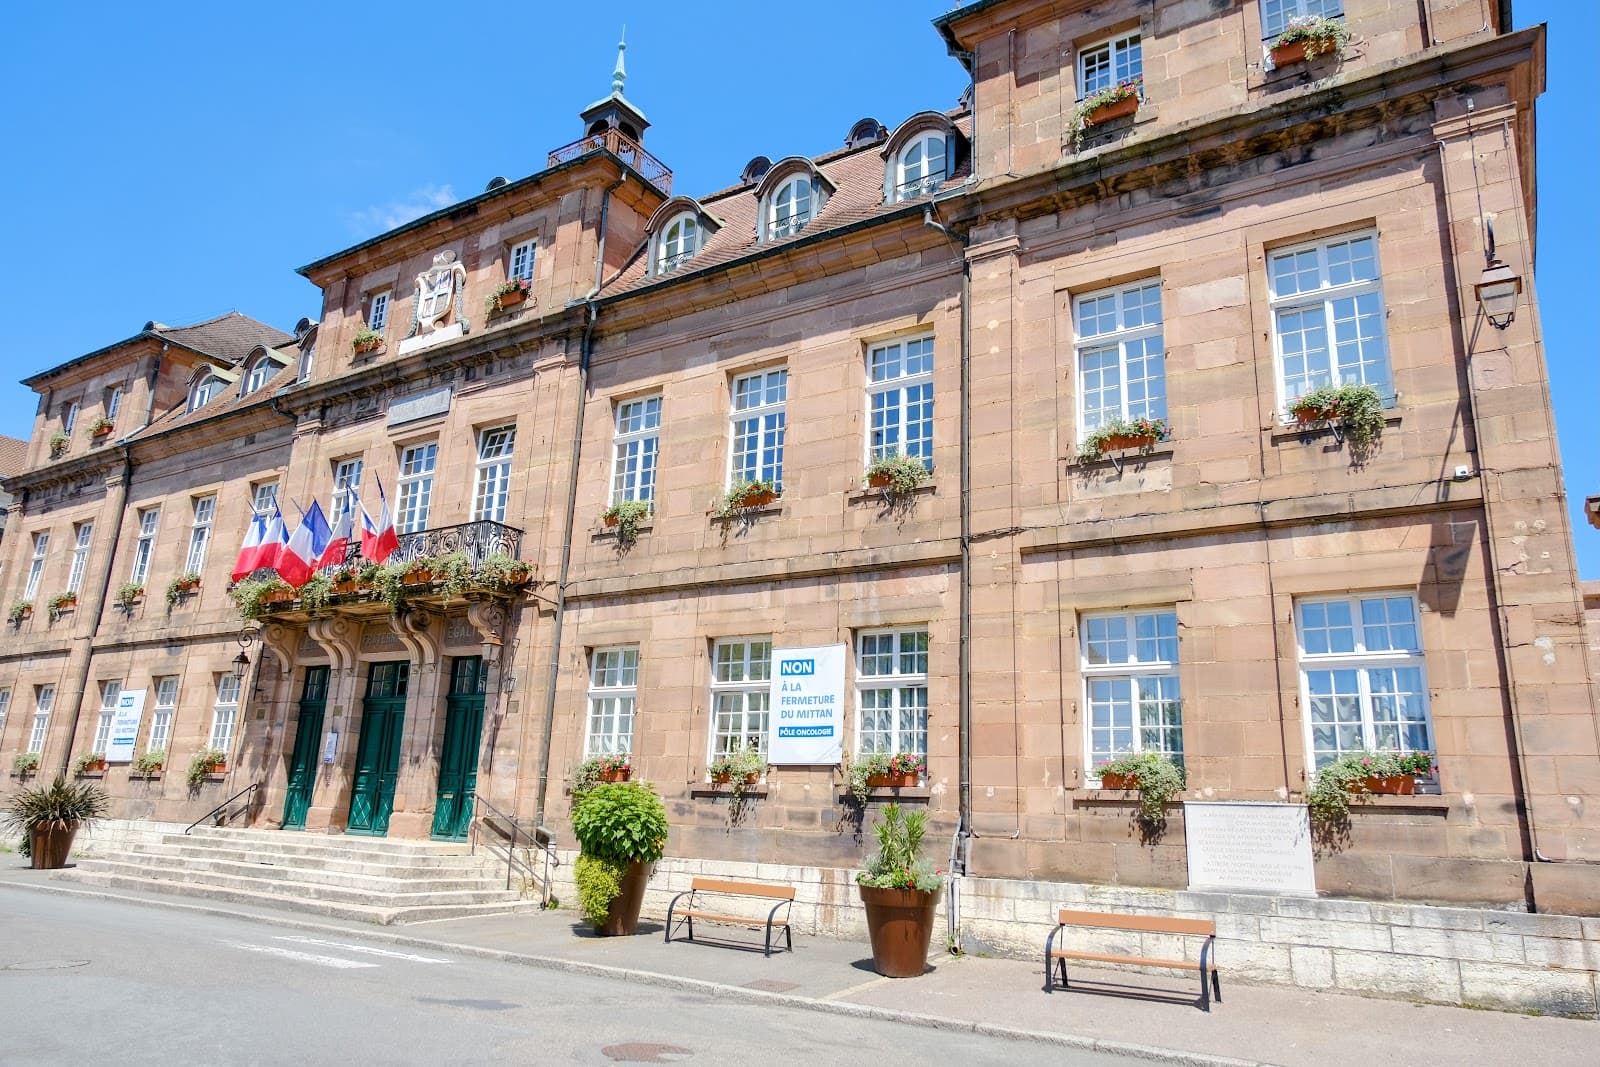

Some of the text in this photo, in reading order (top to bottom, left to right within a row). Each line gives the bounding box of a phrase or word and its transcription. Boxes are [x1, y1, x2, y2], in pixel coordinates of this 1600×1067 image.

[782, 661, 812, 674] NON
[781, 681, 802, 692] À LA
[781, 694, 835, 705] FERMETURE
[780, 708, 833, 719] DU MITTAN
[780, 727, 832, 736] PÔLE ONCOLOGIE
